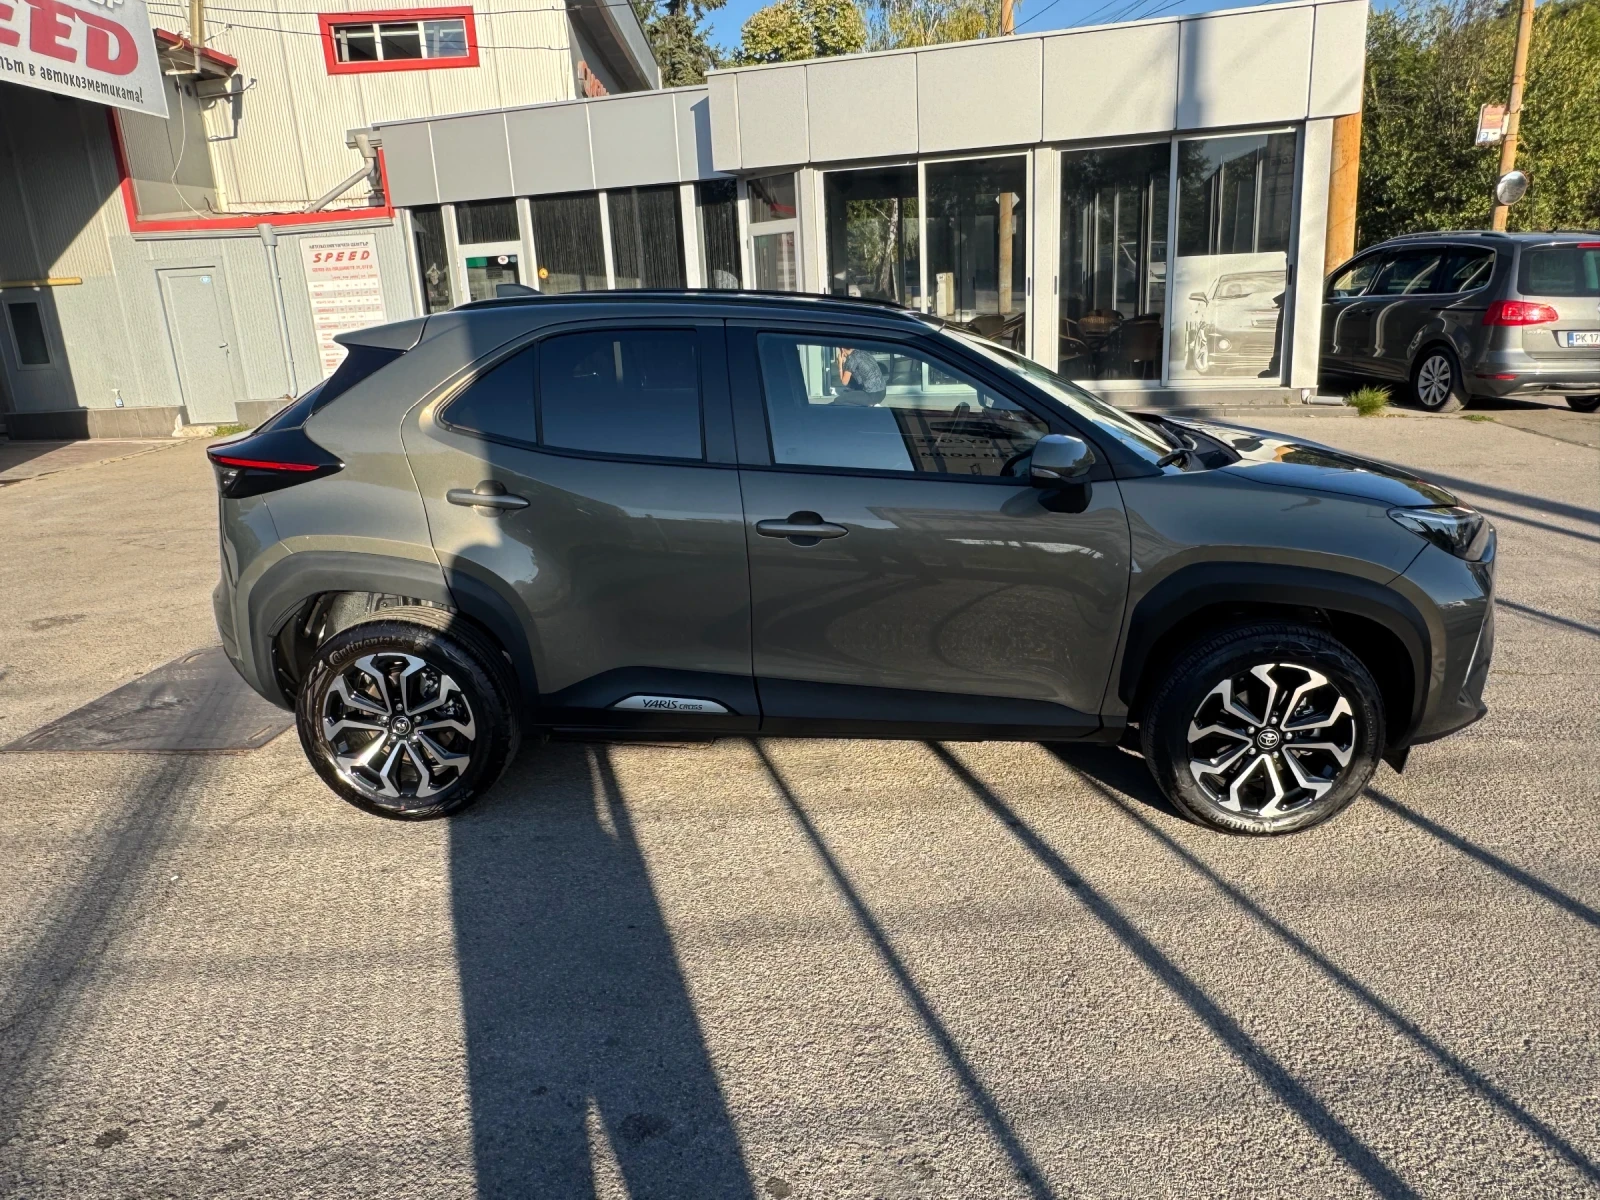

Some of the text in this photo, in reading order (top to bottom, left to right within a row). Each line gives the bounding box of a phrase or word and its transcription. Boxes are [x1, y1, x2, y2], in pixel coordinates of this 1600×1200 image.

[29, 63, 36, 77] в
[39, 65, 144, 104] автокозметиката!
[313, 250, 370, 263] SPEED
[642, 699, 678, 710] YARIS
